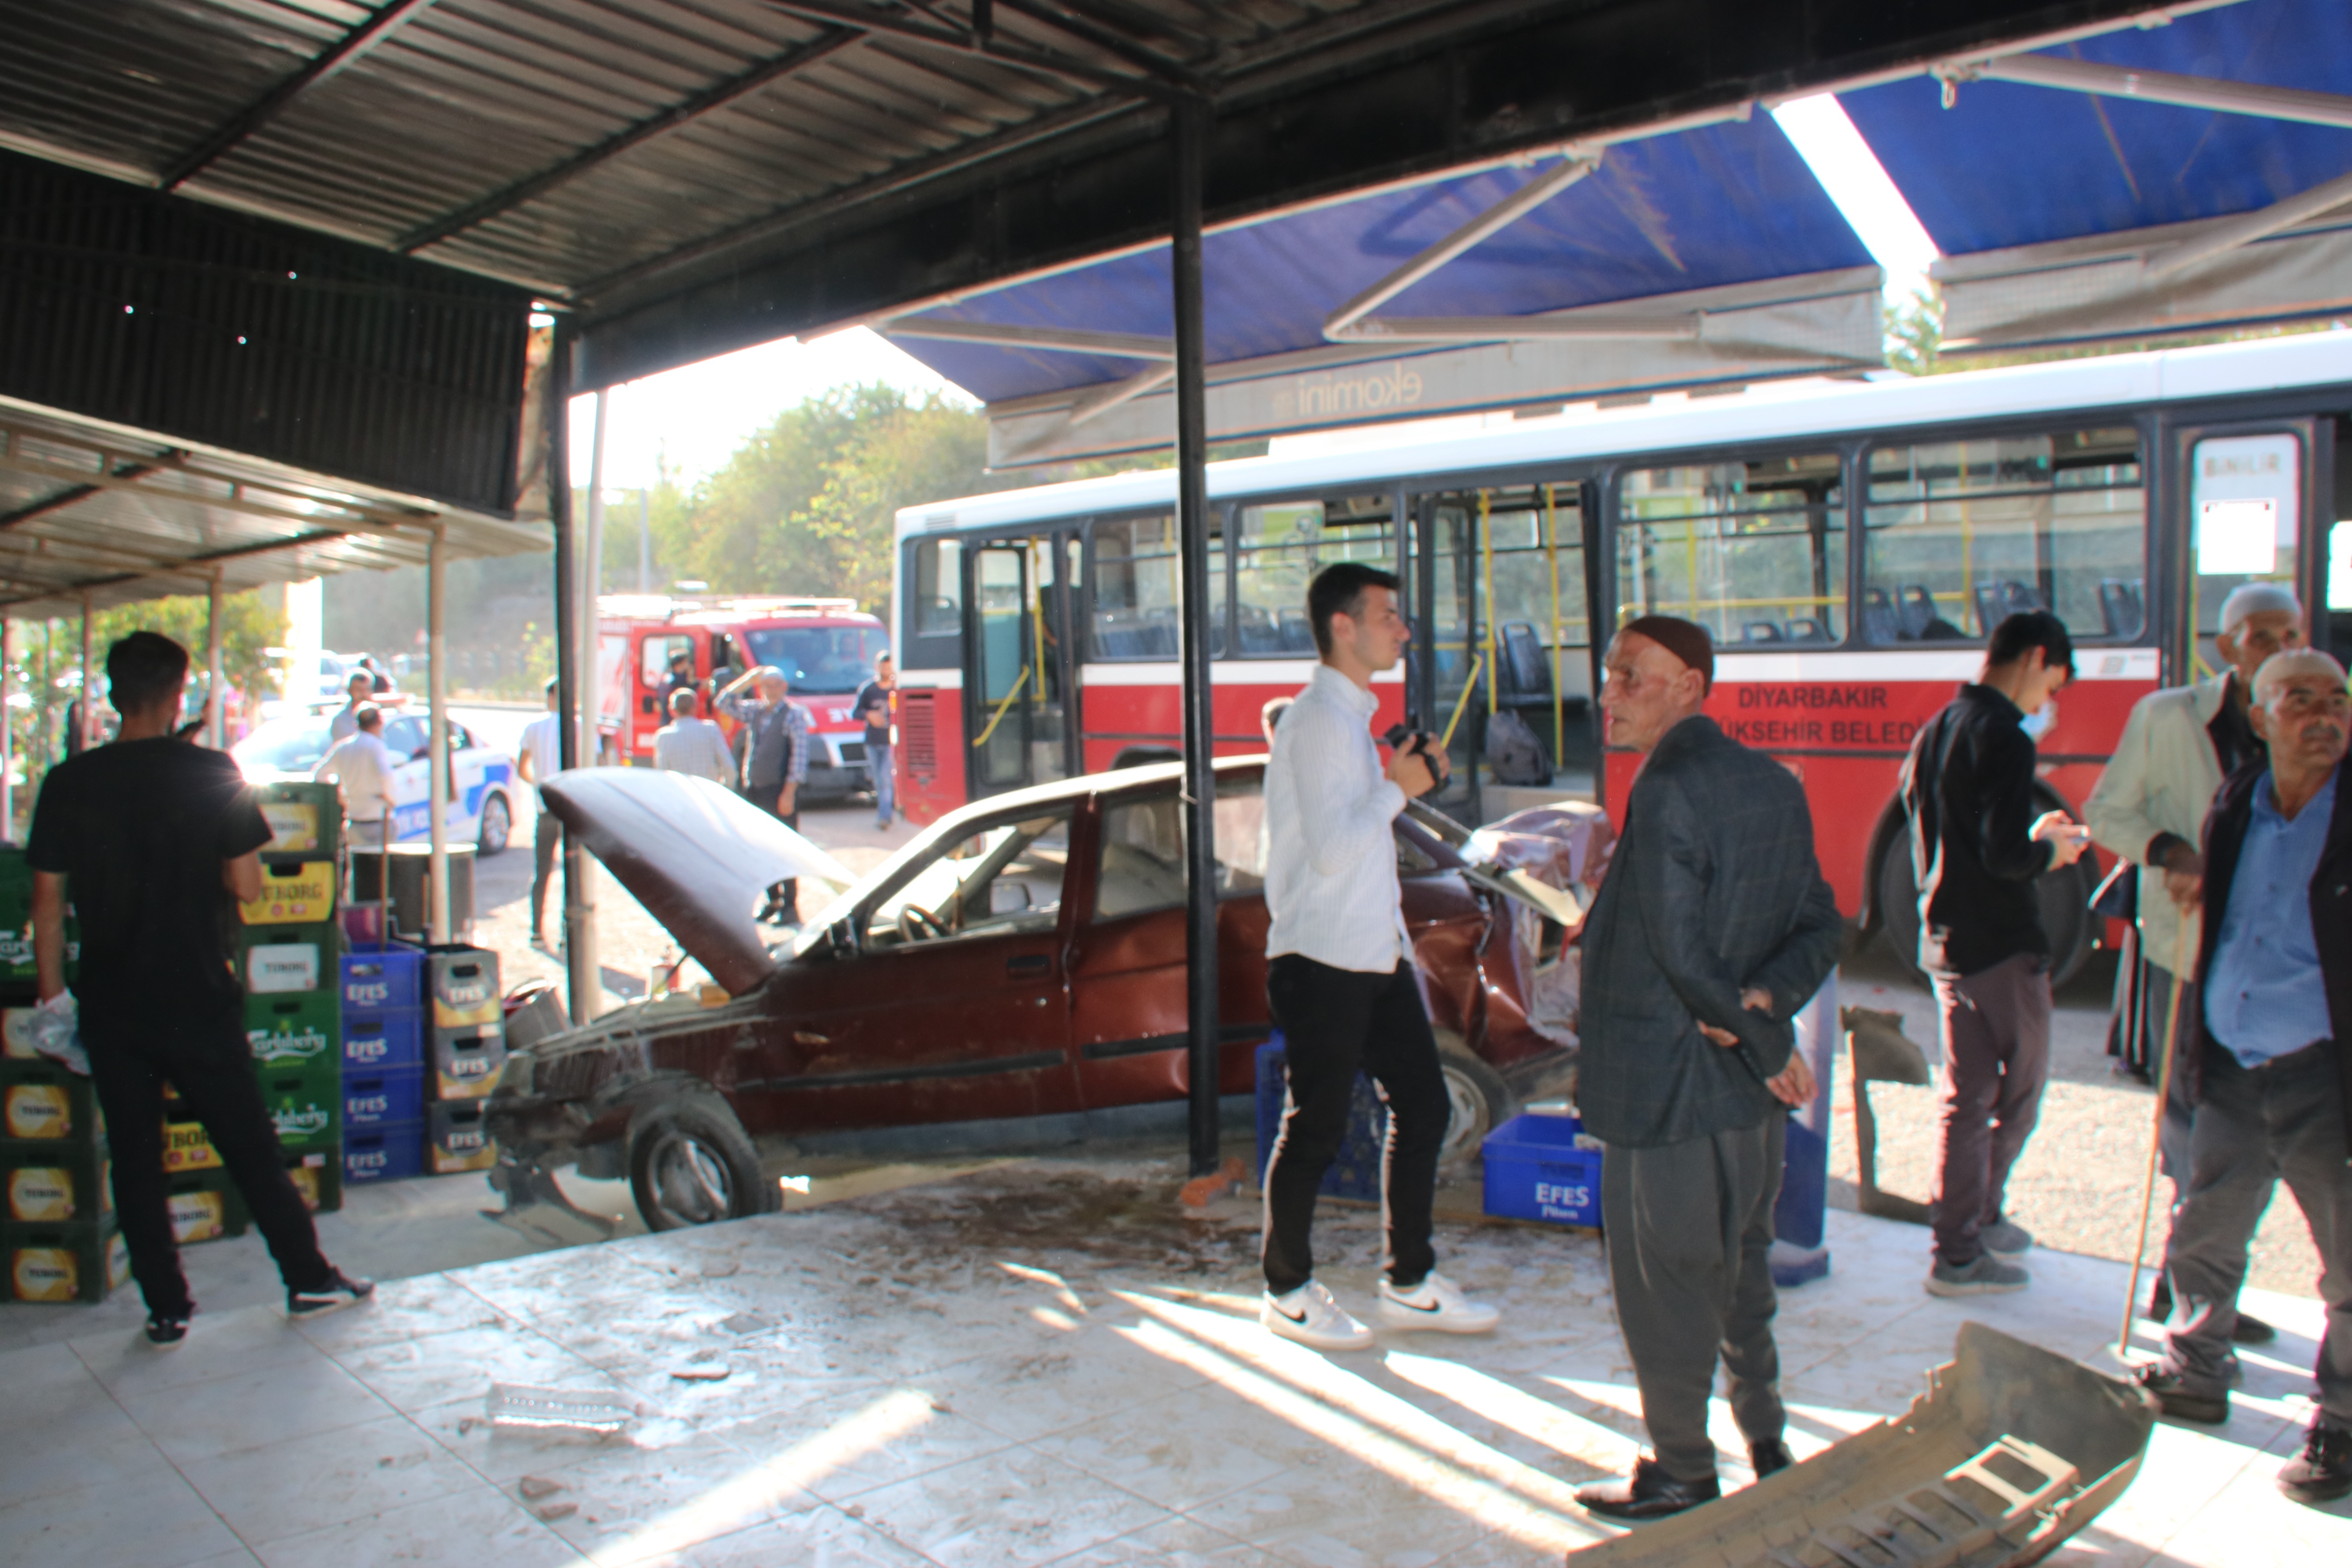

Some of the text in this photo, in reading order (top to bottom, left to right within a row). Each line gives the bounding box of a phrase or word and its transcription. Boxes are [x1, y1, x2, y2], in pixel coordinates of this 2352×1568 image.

[1739, 682, 1888, 709] DİYARBAKIR
[261, 882, 323, 901] UBORG
[450, 984, 487, 1004] EFES
[347, 1038, 388, 1058] EFES
[452, 1056, 490, 1076] EFES
[448, 1130, 485, 1149] EFES
[1535, 1181, 1590, 1208] EFES
